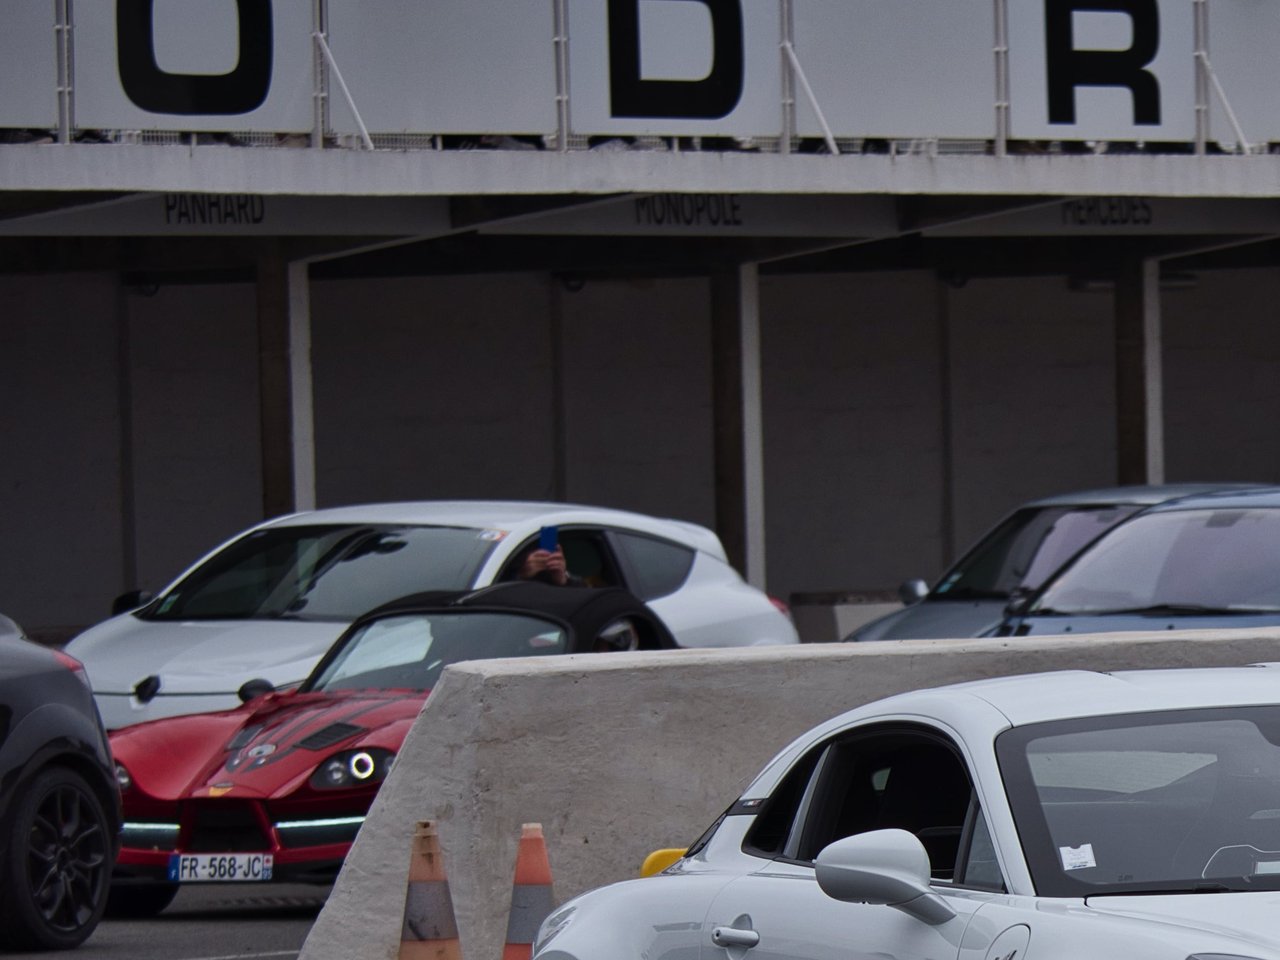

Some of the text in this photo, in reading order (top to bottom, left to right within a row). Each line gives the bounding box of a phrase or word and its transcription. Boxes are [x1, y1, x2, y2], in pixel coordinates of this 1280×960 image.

[164, 194, 265, 225] PANHARD
[635, 194, 743, 226] MONOPOLE
[1061, 197, 1153, 225] MERCEDES
[181, 856, 262, 878] FR-568-JC
